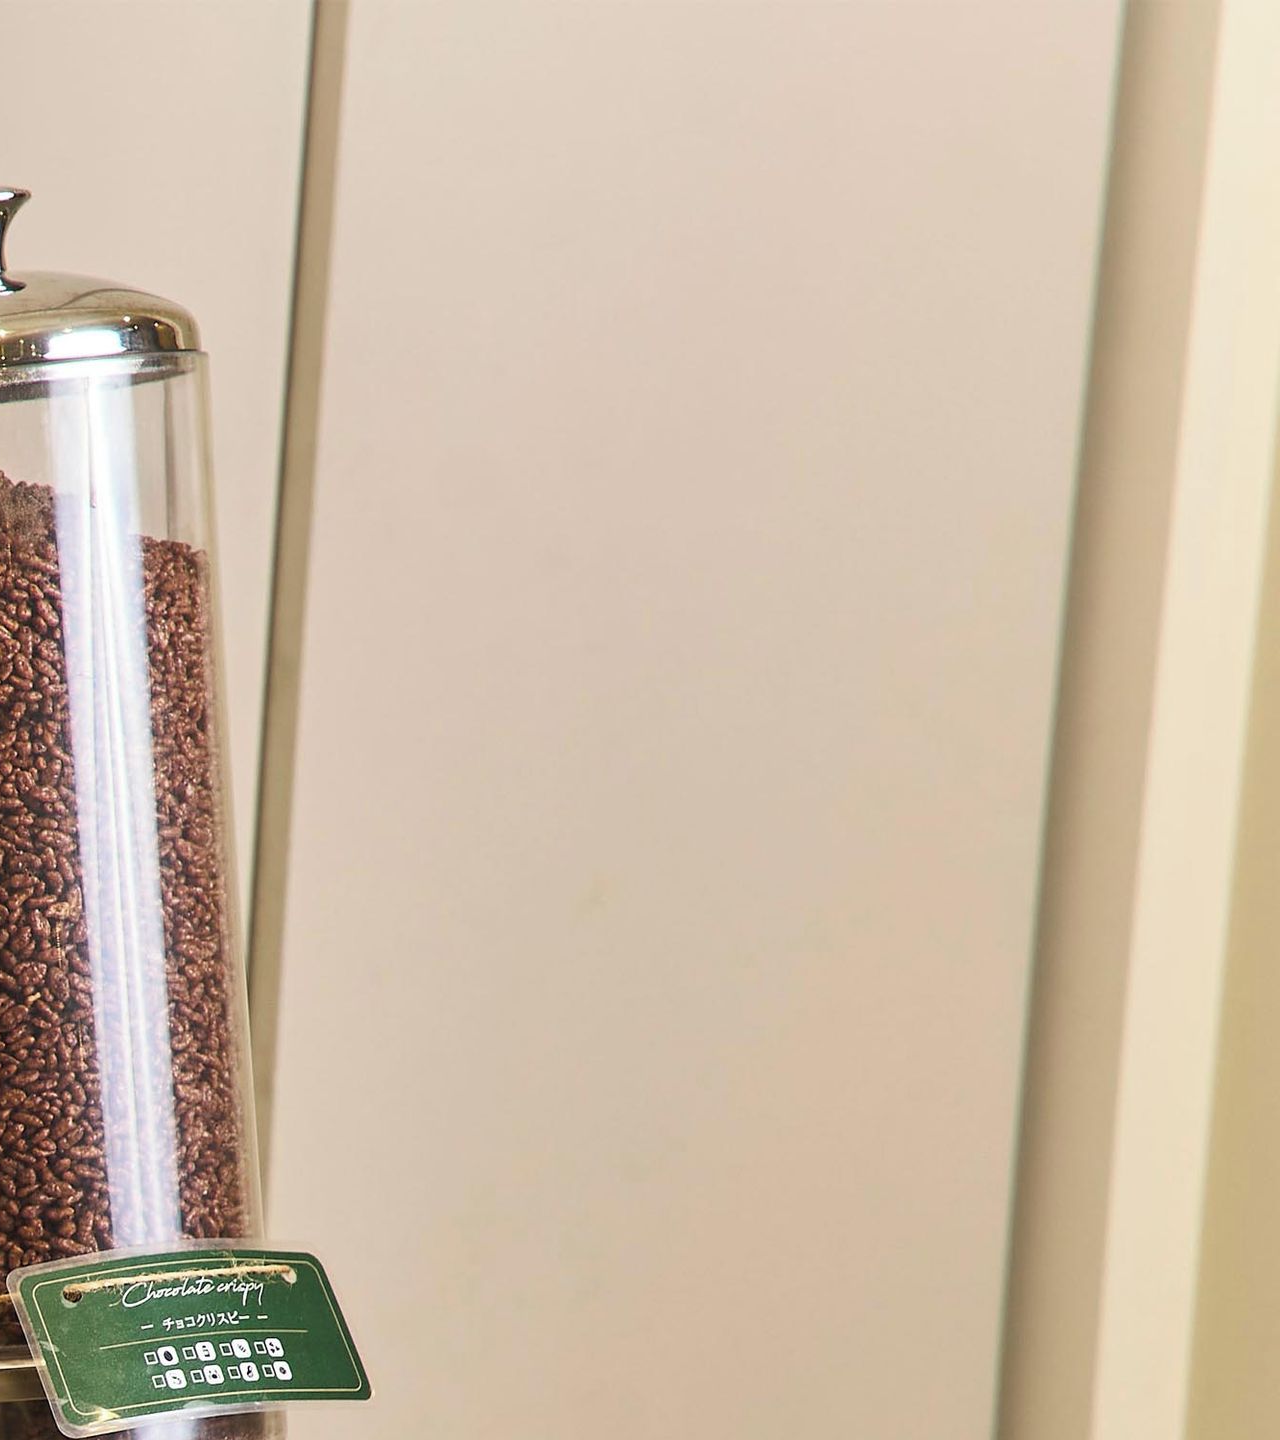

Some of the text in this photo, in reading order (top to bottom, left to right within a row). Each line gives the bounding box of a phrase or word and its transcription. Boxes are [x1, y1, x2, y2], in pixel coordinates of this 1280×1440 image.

[122, 1277, 264, 1308] Chocolate crispy
[162, 1310, 250, 1331] チョコクリスピー
